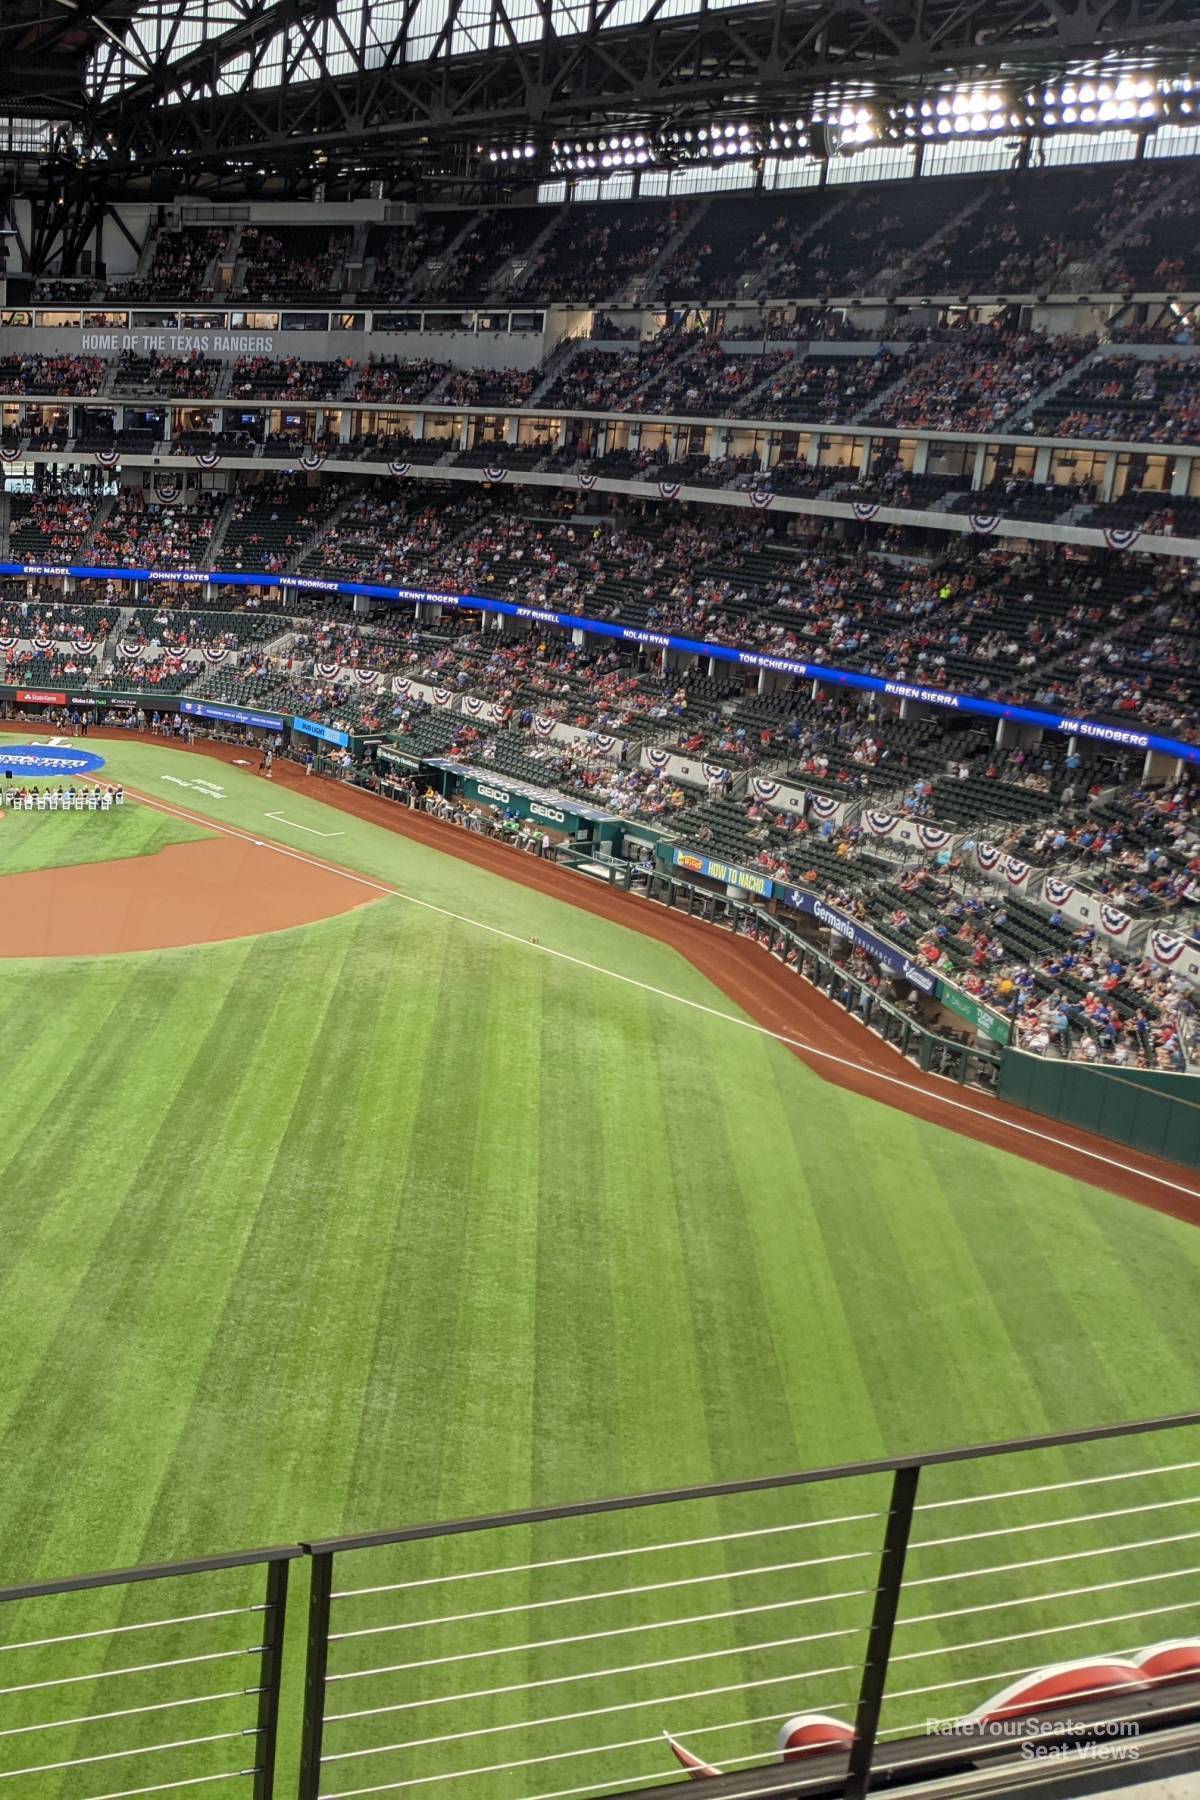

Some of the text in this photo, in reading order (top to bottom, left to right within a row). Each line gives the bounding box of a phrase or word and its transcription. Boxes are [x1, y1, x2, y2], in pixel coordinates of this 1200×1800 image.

[82, 335, 273, 352] HOME OF THE TEXAS RANGERS
[23, 566, 71, 575] ERIC NADEL
[148, 572, 209, 582] JOHNNY OATES
[399, 591, 458, 604] KENNY ROGERS
[516, 607, 560, 623] JEFF RUSSELL
[623, 629, 669, 646] NOLAN RYAN
[739, 653, 806, 674] TOM SCHIEFFER
[884, 683, 958, 707] RUBEN SIERRA
[1058, 720, 1149, 746] JIM SUNDBERG
[477, 784, 510, 804] GEICO
[530, 802, 565, 823] GEICO
[708, 861, 766, 895] HOW TO NACHO.
[813, 900, 892, 965] Germania INSURANCE
